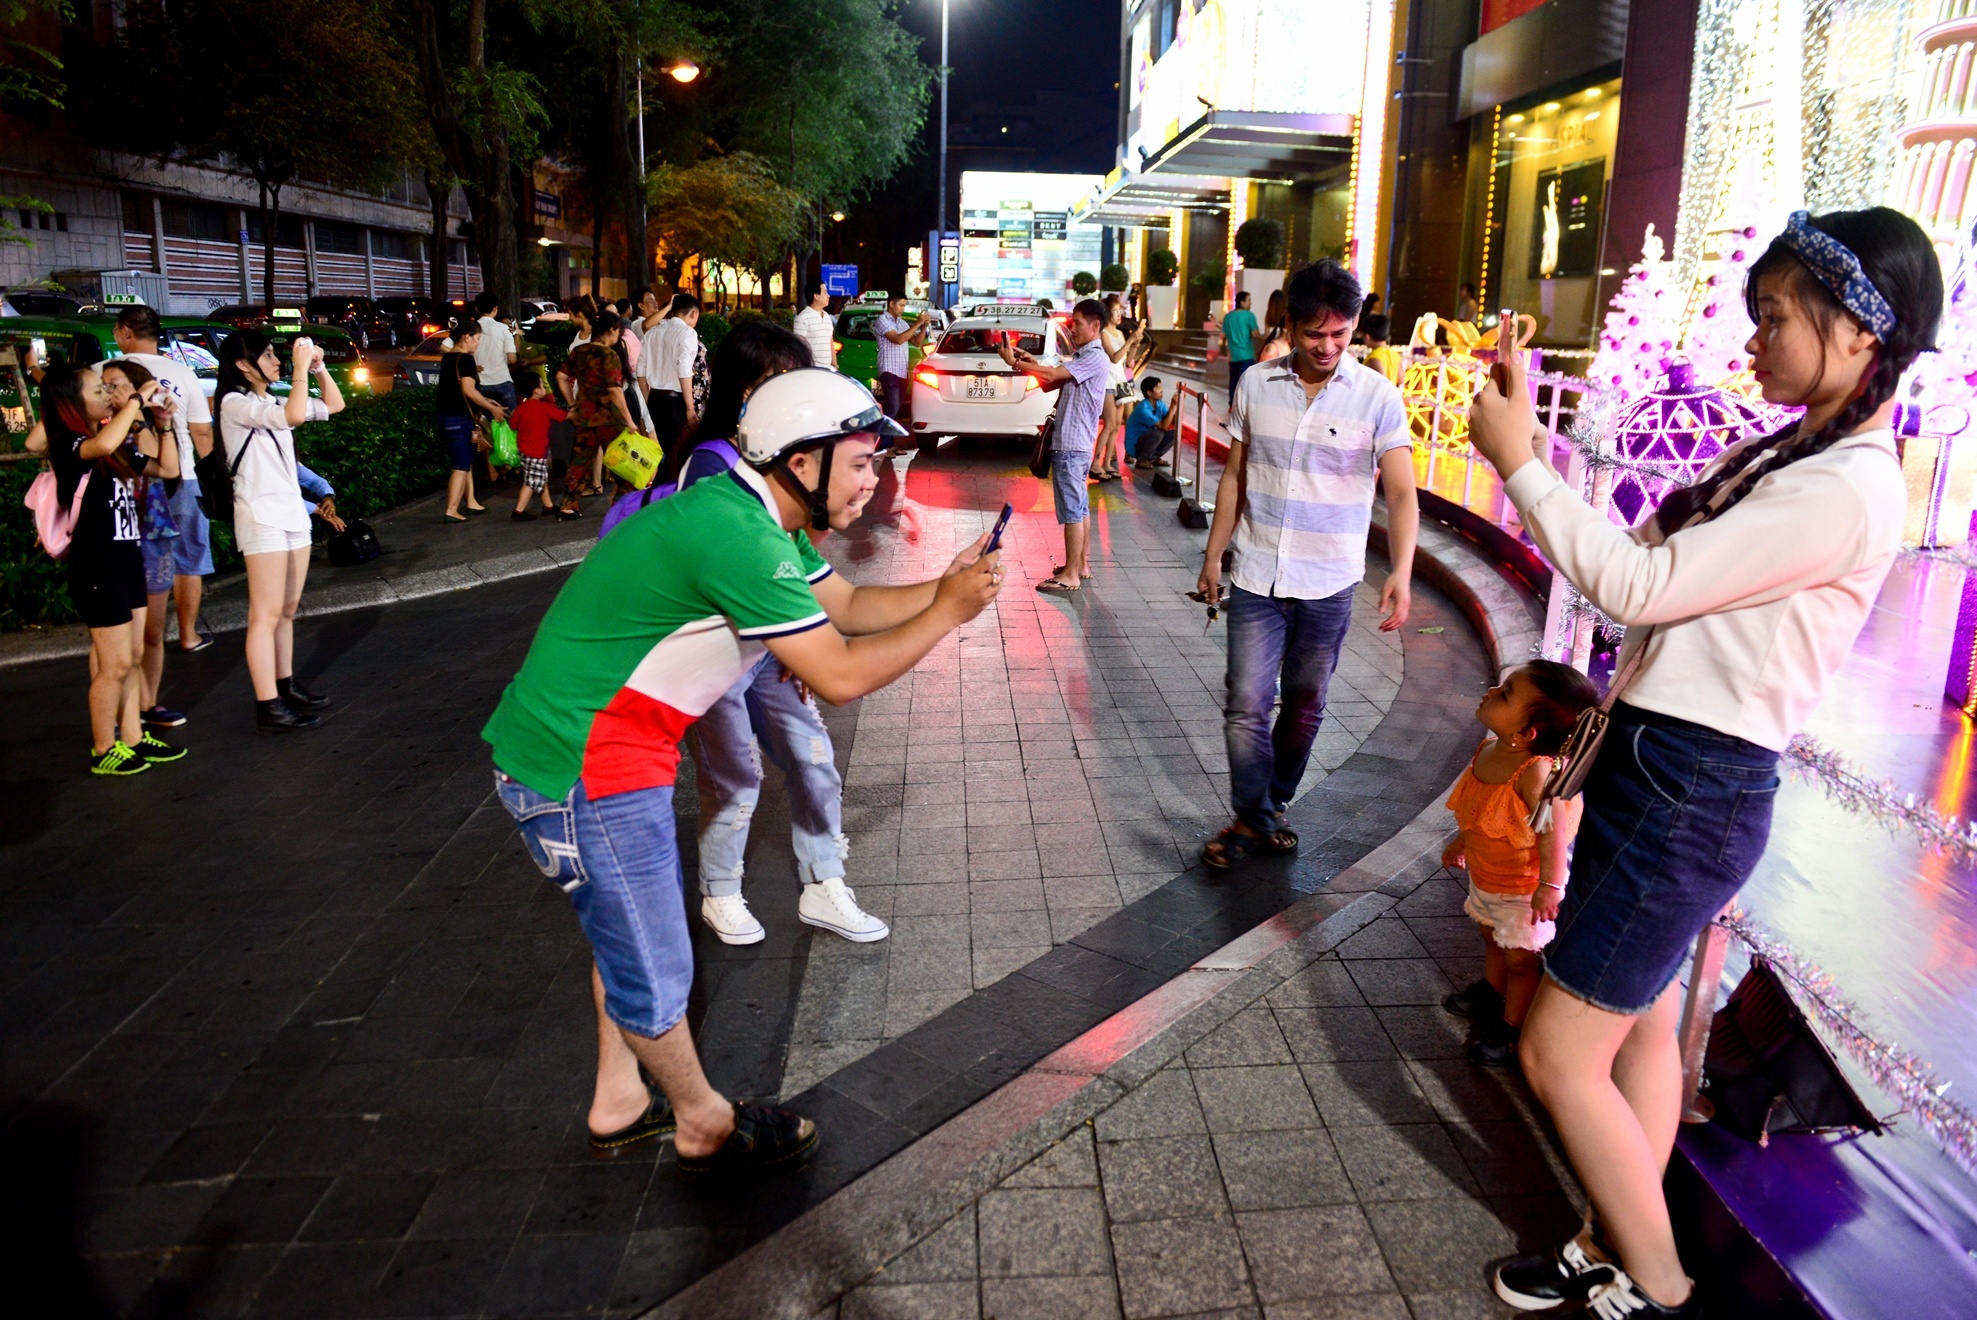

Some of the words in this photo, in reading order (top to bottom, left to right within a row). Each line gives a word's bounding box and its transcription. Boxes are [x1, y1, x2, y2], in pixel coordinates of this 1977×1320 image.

[110, 295, 131, 303] TAXI
[1030, 307, 1041, 315] 27
[974, 378, 989, 387] 51A
